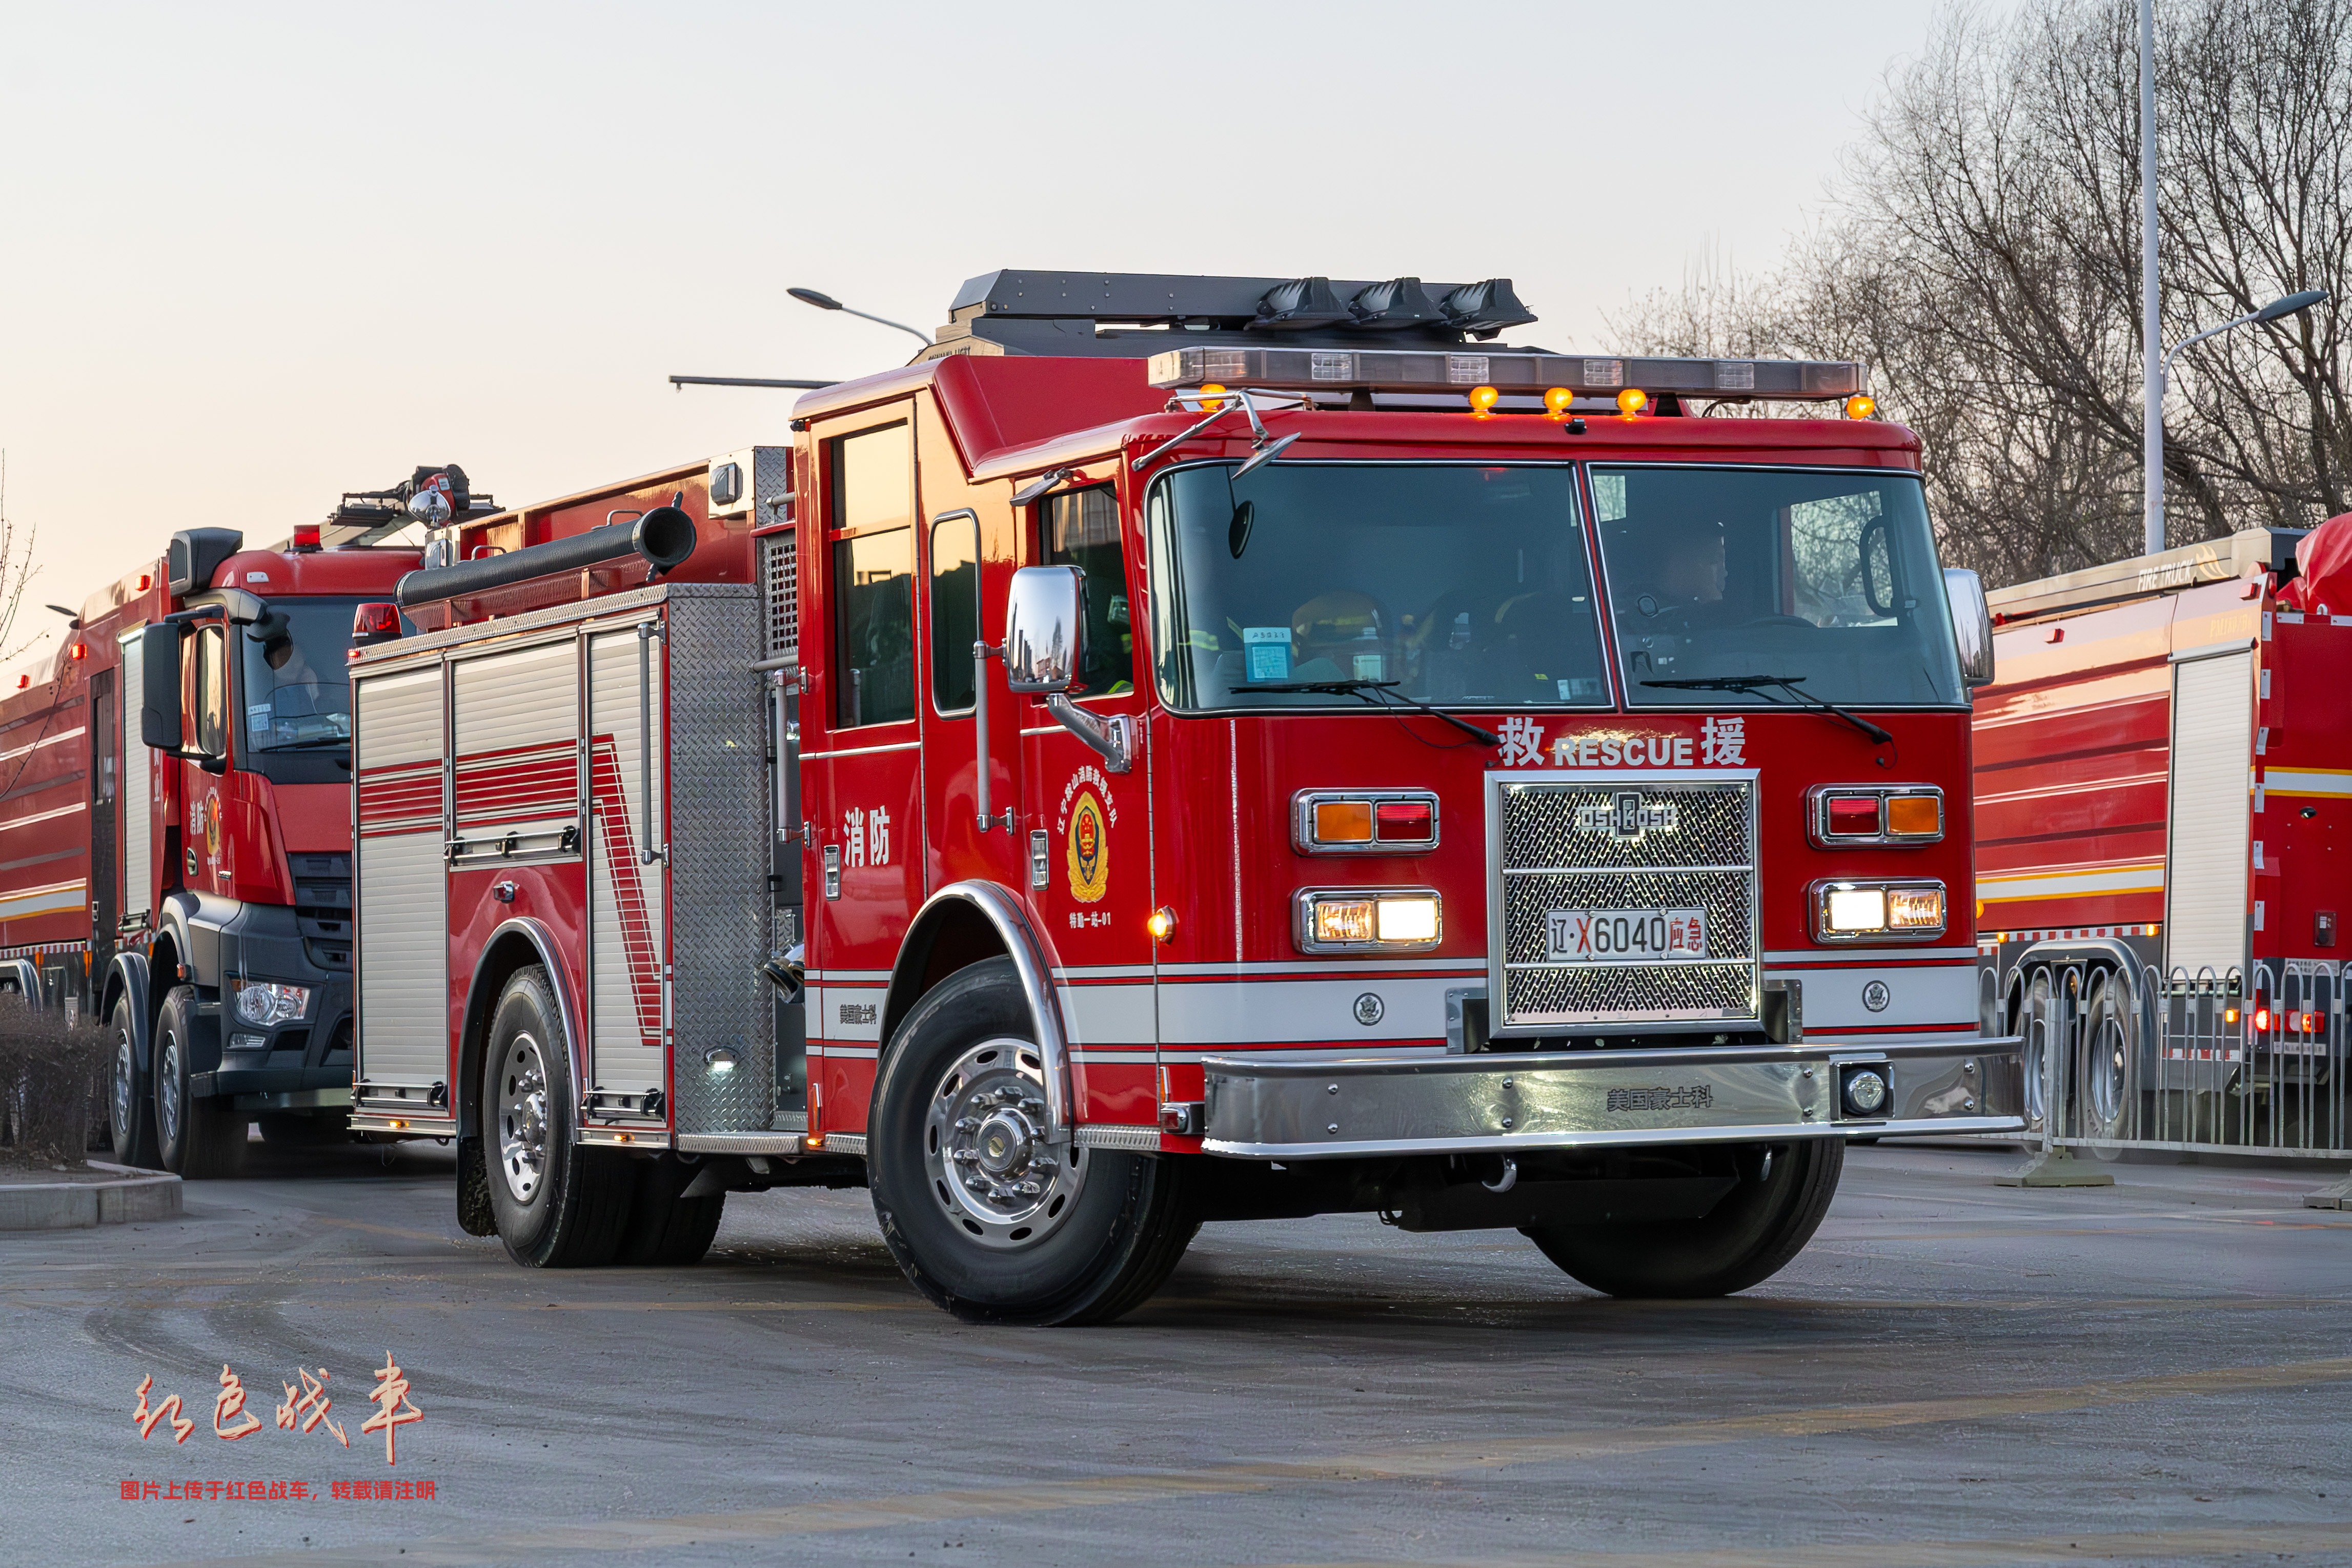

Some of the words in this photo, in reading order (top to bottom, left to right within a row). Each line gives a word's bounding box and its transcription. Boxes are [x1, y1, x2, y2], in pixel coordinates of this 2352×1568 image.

[2137, 566, 2159, 593] FIRE
[2161, 558, 2193, 585] TRUCK
[1497, 717, 1545, 766] 救
[1554, 738, 1694, 766] RESCUE
[1701, 717, 1747, 766] 援
[190, 800, 204, 836] 消防
[1580, 808, 1676, 827] OSHKOSH
[843, 805, 890, 868] 消防
[1607, 1085, 1714, 1112] 美国豪士科
